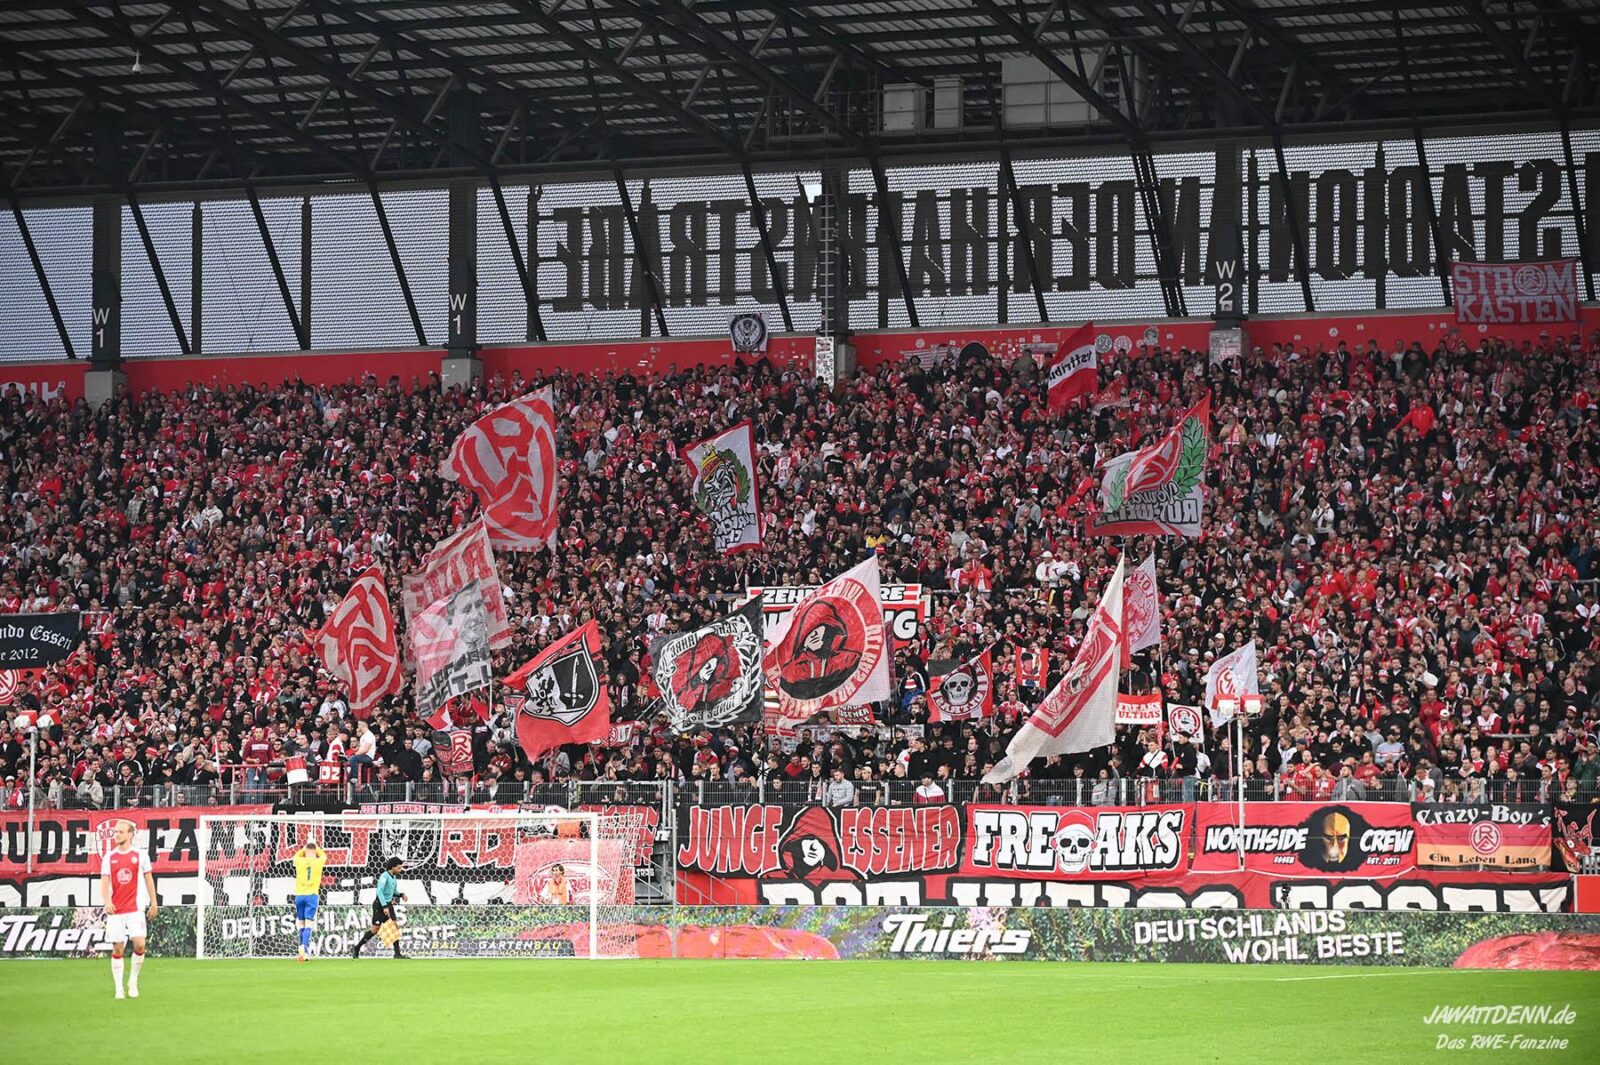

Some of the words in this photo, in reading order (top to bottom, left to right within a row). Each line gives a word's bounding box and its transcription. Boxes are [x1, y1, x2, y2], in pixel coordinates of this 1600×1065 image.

[1215, 260, 1236, 280] W
[449, 293, 467, 311] W
[1219, 282, 1234, 305] 2
[92, 307, 110, 325] W
[1456, 296, 1577, 323] KASTEN
[453, 314, 461, 335] 1
[96, 327, 104, 348] 1
[30, 625, 71, 650] Essen
[9, 648, 38, 660] 2012
[0, 820, 89, 864] UDE
[677, 804, 782, 875] JUNGE
[841, 804, 962, 875] ESSENER
[1205, 827, 1309, 852] NORTHSIDE
[1359, 829, 1414, 852] CREW
[1459, 854, 1496, 864] Leben
[306, 866, 312, 881] 1
[882, 913, 1032, 953] Thiers
[1134, 911, 1346, 945] DEUTSCHLANDS
[376, 939, 459, 950] GRTENBAU
[479, 939, 562, 950] GARTENBAU
[1223, 938, 1309, 963] WOHL
[1317, 932, 1404, 959] BESTE
